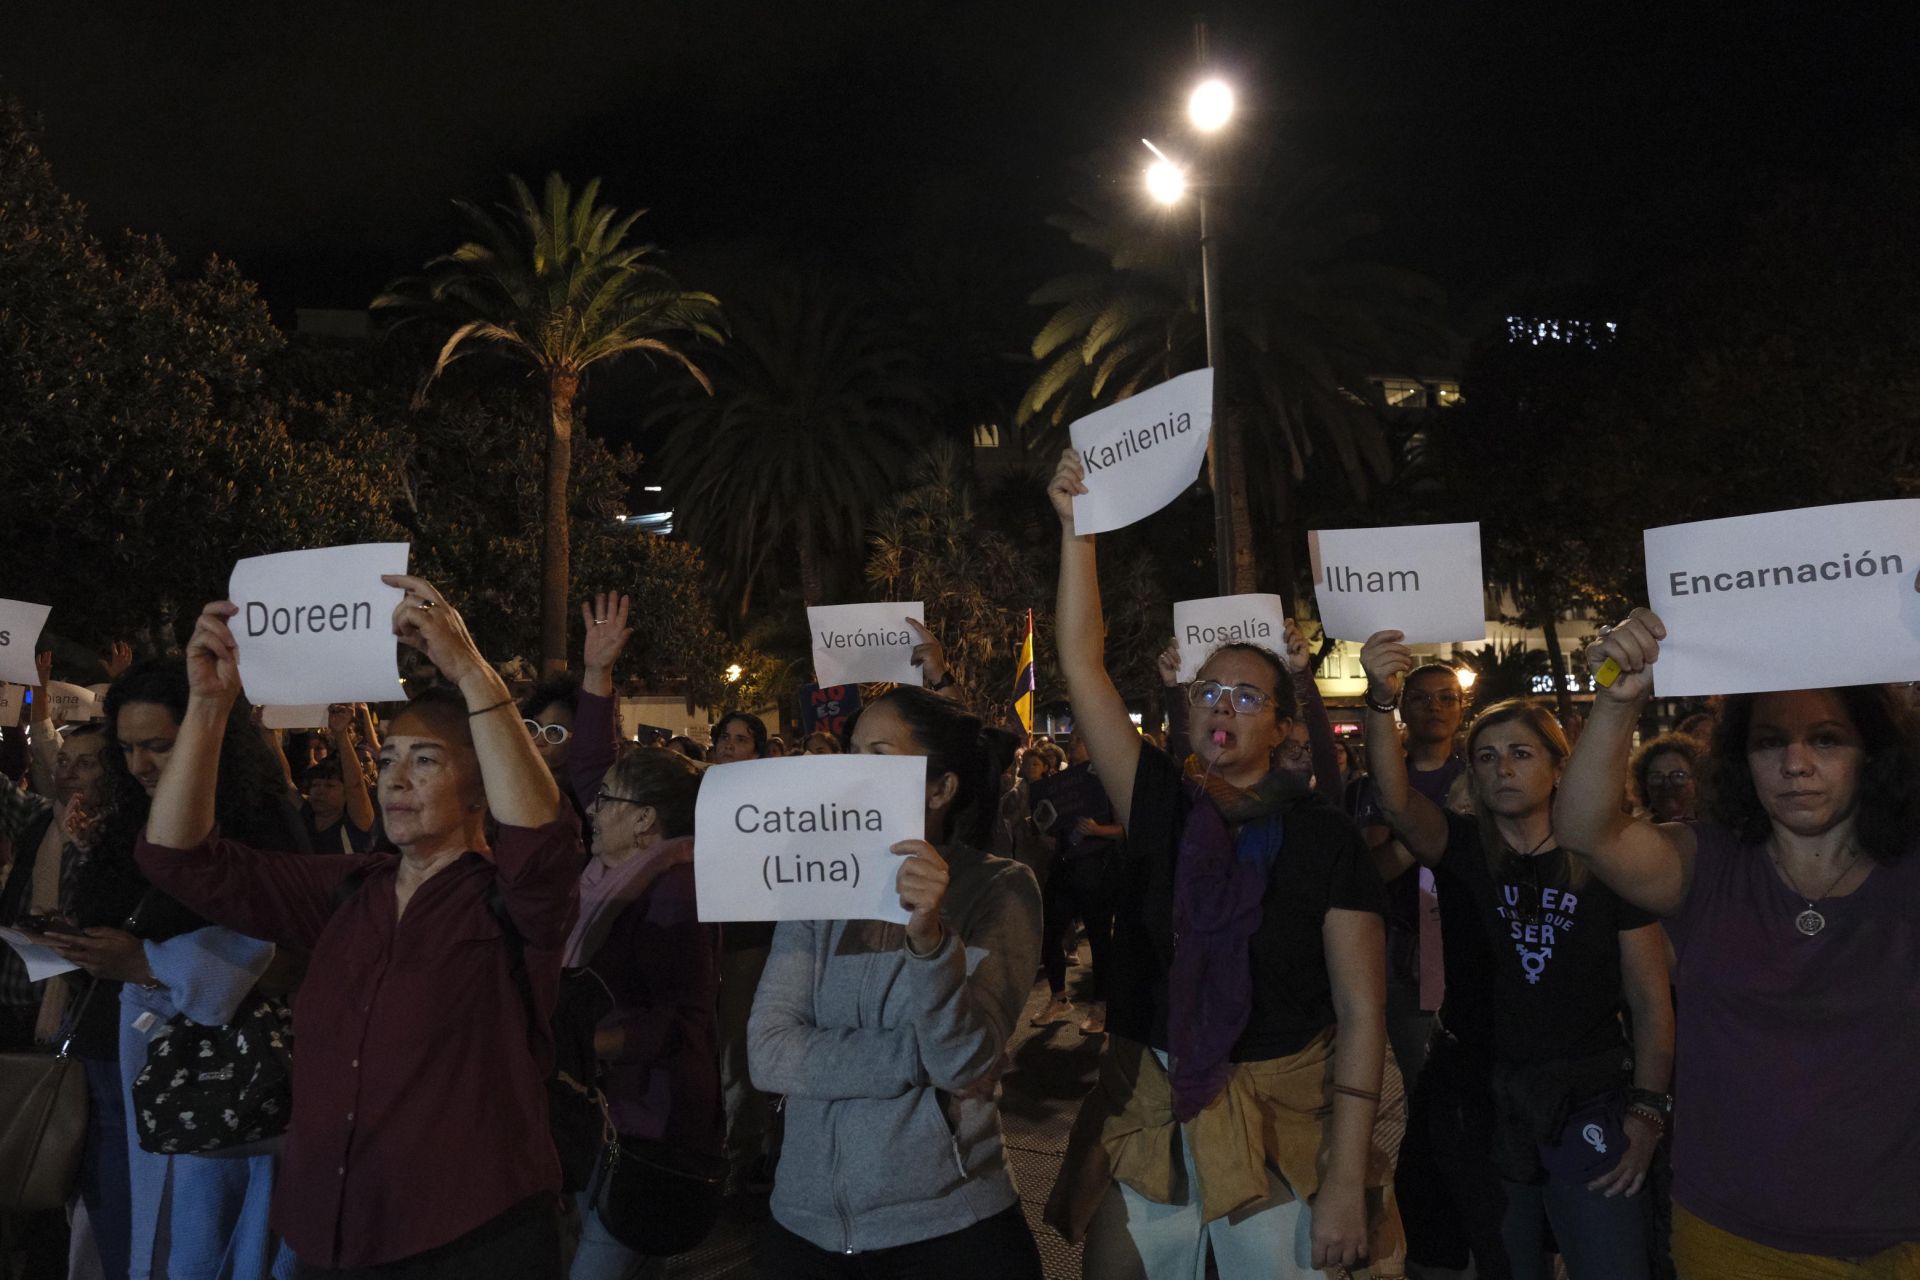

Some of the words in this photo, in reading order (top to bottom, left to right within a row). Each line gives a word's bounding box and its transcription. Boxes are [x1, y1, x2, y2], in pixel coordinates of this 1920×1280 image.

[1082, 412, 1192, 475] Karilenia
[1325, 565, 1420, 593] Ilham
[1669, 549, 1904, 597] Encarnación
[245, 600, 372, 638] Doreen
[1185, 617, 1271, 646] Rosalía
[820, 627, 912, 650] Verónica
[812, 685, 846, 704] NO
[817, 701, 840, 718] ES
[734, 803, 883, 834] Catalina
[762, 852, 861, 891] (Lina)
[1504, 885, 1578, 914] UER
[1511, 920, 1555, 944] SER
[1545, 912, 1574, 931] QUE
